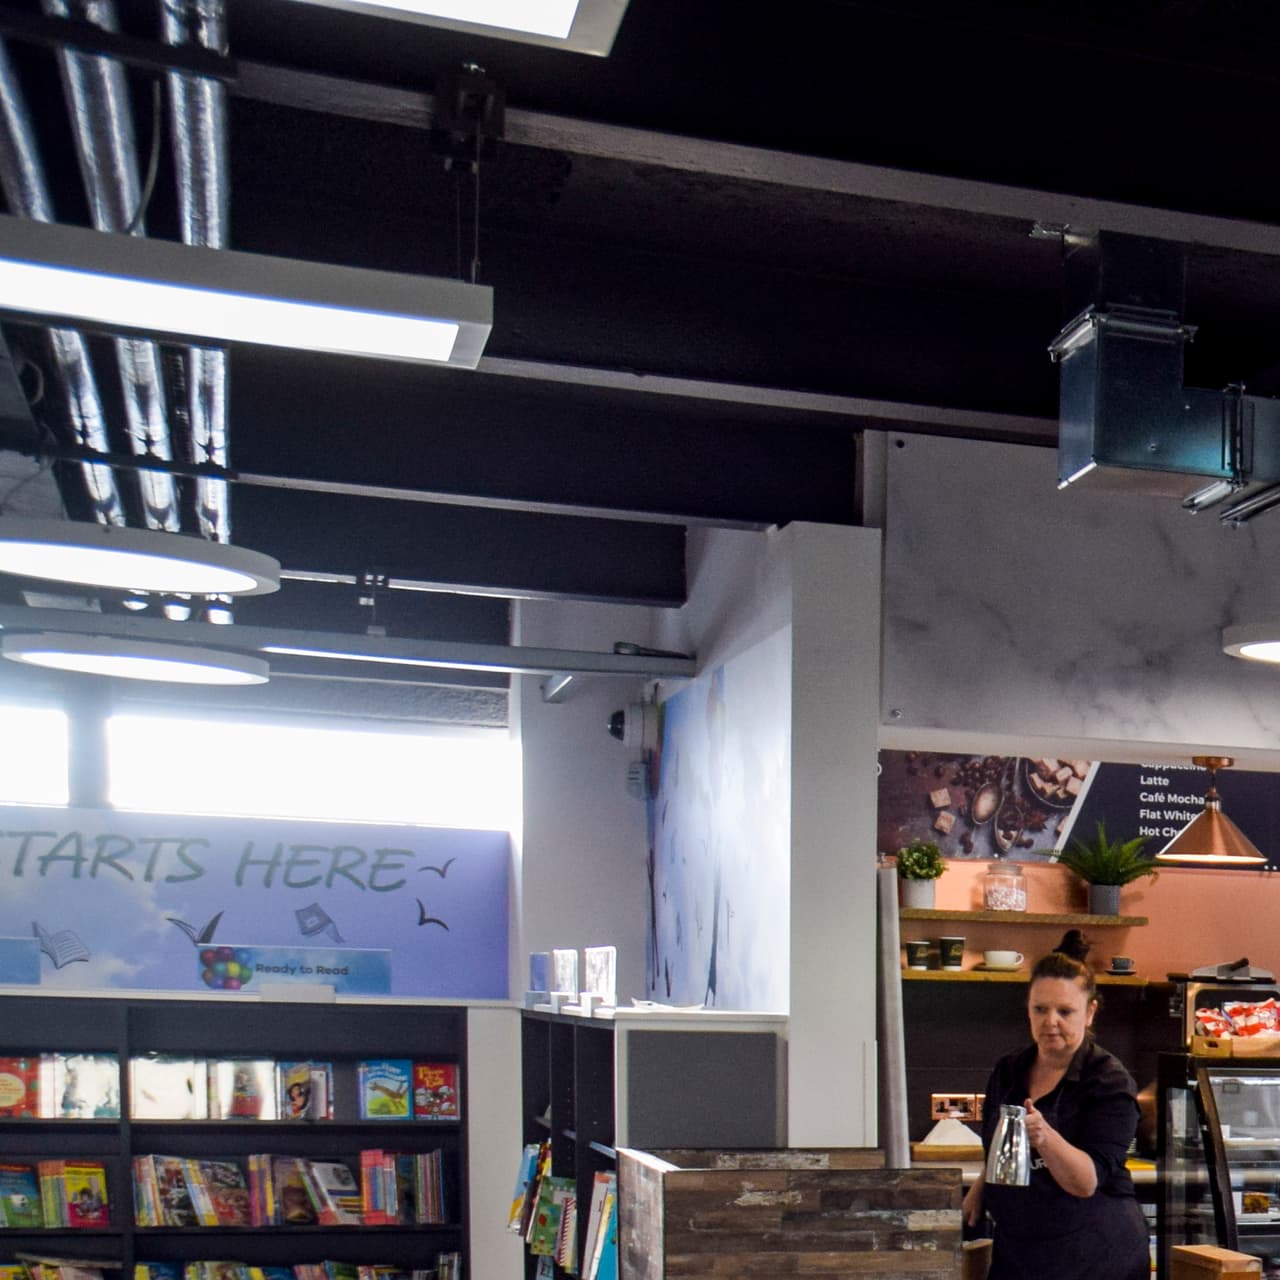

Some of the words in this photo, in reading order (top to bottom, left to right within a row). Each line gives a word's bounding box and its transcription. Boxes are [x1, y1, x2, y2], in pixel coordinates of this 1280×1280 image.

[1140, 776, 1169, 787] Latte
[1140, 792, 1165, 803] Café
[1168, 794, 1205, 805] Mocha
[1140, 809, 1161, 820] Flat
[1139, 826, 1160, 837] Hot
[0, 829, 210, 884] TARTS
[234, 840, 416, 893] HERE
[256, 963, 296, 977] Ready
[300, 965, 312, 975] to
[316, 965, 349, 977] Read
